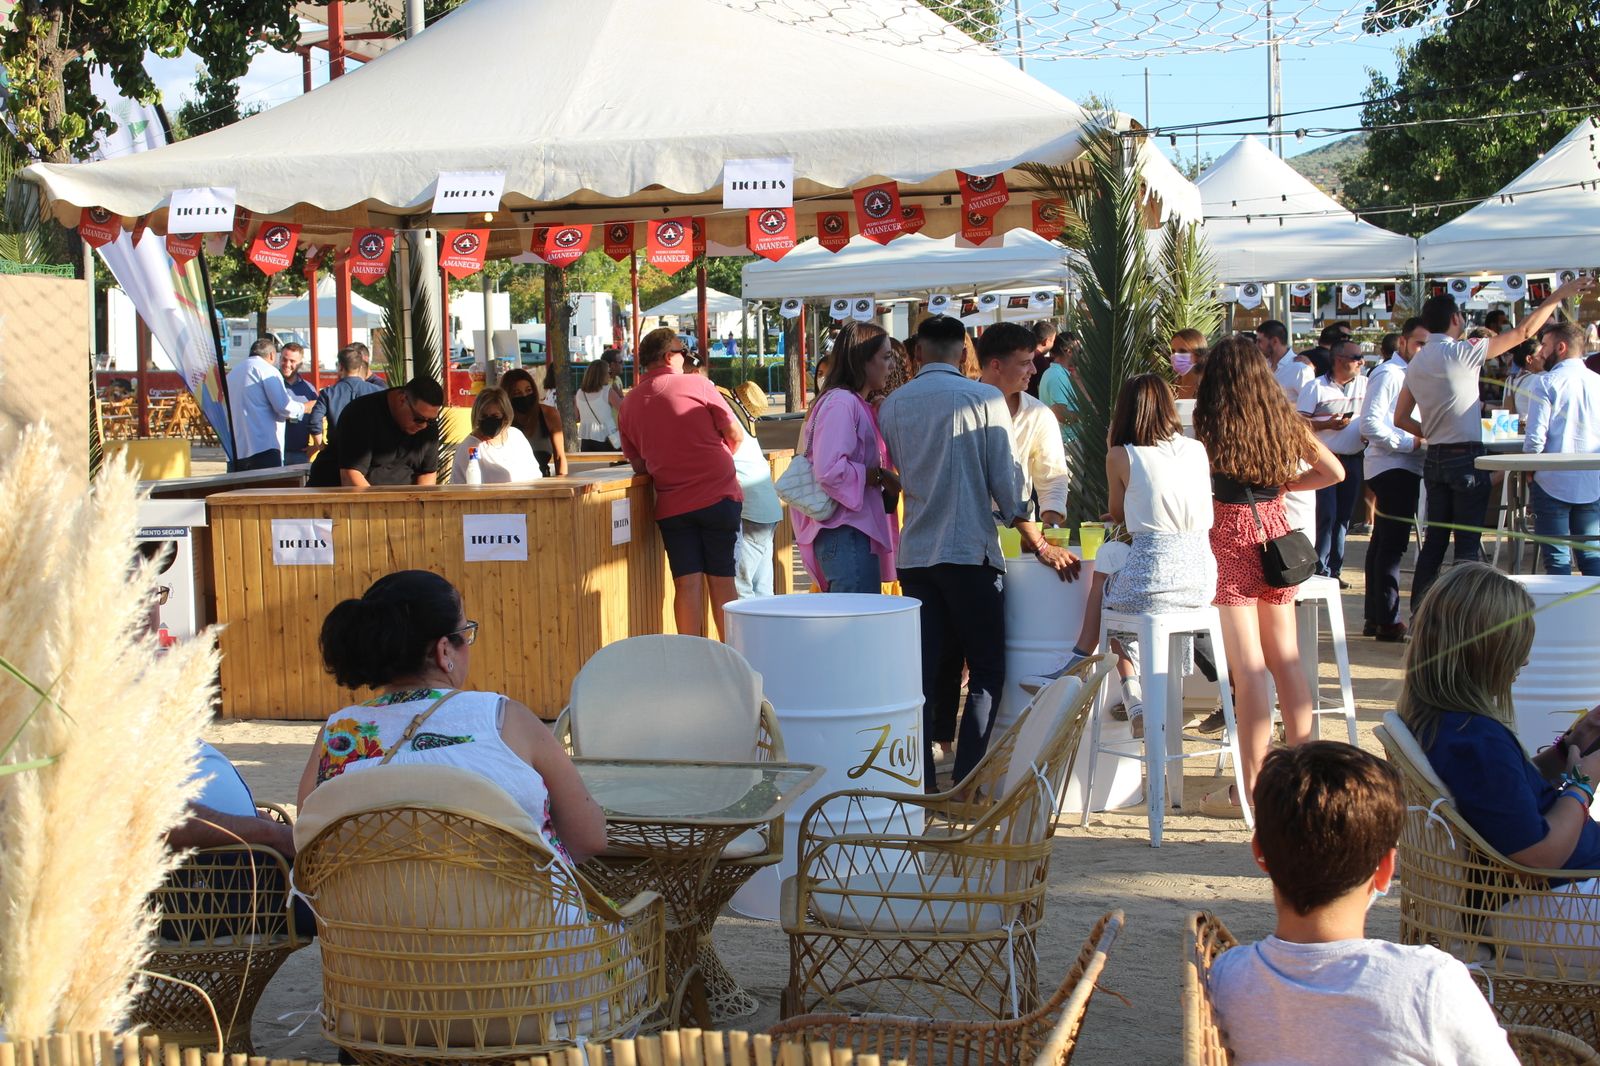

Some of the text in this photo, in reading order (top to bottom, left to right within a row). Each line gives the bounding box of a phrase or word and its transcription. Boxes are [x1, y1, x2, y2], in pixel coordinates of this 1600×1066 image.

[732, 180, 786, 190] TICKETS
[443, 190, 494, 198] TICKETS
[968, 194, 1007, 211] AMANECER
[175, 206, 228, 216] TICKETS
[863, 222, 902, 236] AMANECER
[81, 228, 112, 241] AMANECER
[755, 240, 794, 251] AMANECER
[168, 245, 196, 257] AMANECER
[546, 250, 584, 260] AMANECER
[254, 254, 290, 267] AMANECER
[651, 254, 690, 262] AMANECER
[442, 260, 480, 270] AMANECER
[352, 266, 386, 275] AMANECER
[278, 539, 327, 548] TICKETS
[470, 534, 521, 544] TICKETS
[846, 723, 922, 788] Zay
